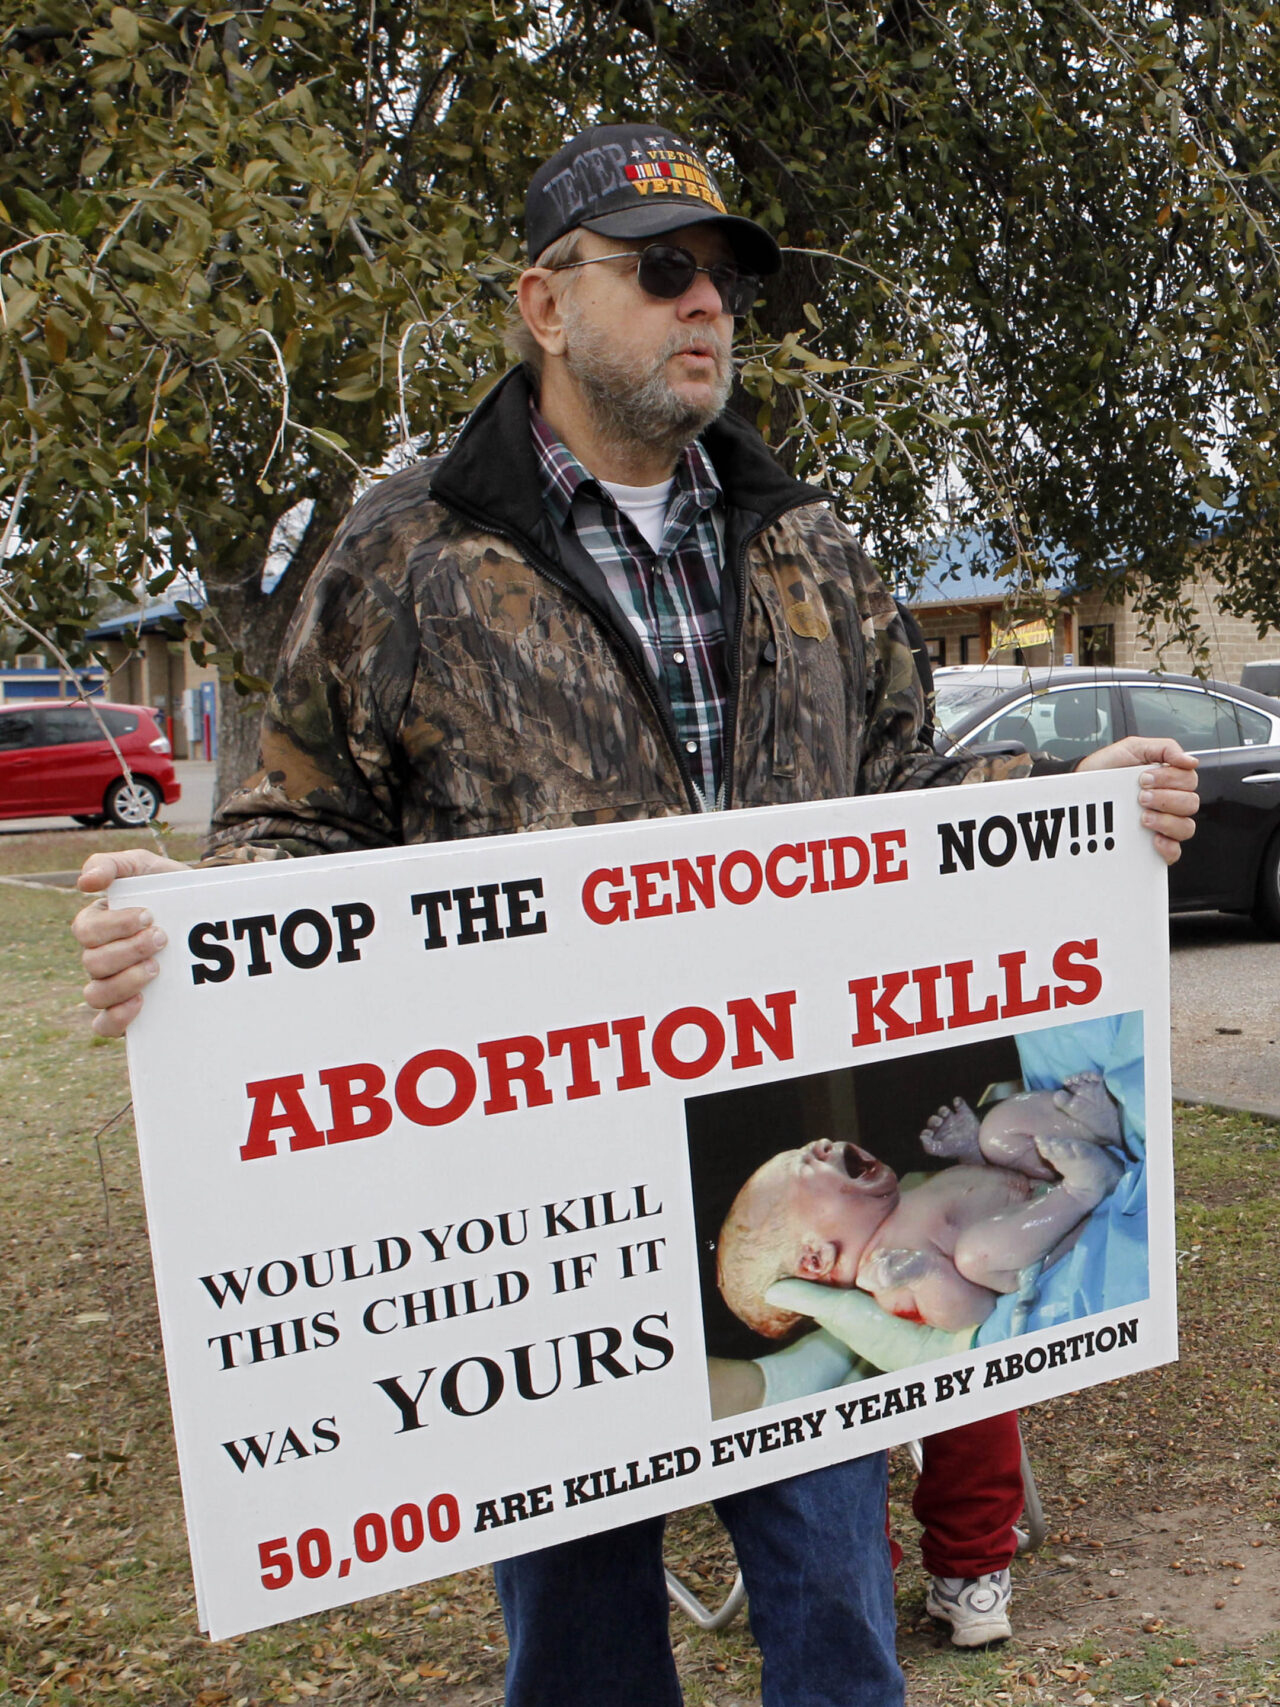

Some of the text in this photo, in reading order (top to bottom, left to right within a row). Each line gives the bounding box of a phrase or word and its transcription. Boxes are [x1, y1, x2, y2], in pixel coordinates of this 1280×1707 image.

[188, 801, 1115, 984] STOP THE GENOCIDE NOW!!!
[239, 939, 1102, 1161] ABORTION KILLS
[199, 1185, 663, 1309] WOULD YOU KILL
[208, 1238, 666, 1371] THIS CHILD IF IT
[221, 1312, 674, 1473] WAS YOURS
[258, 1319, 1139, 1590] 50,000 ARE KILLED EVERY YEAR BY ABORTION
